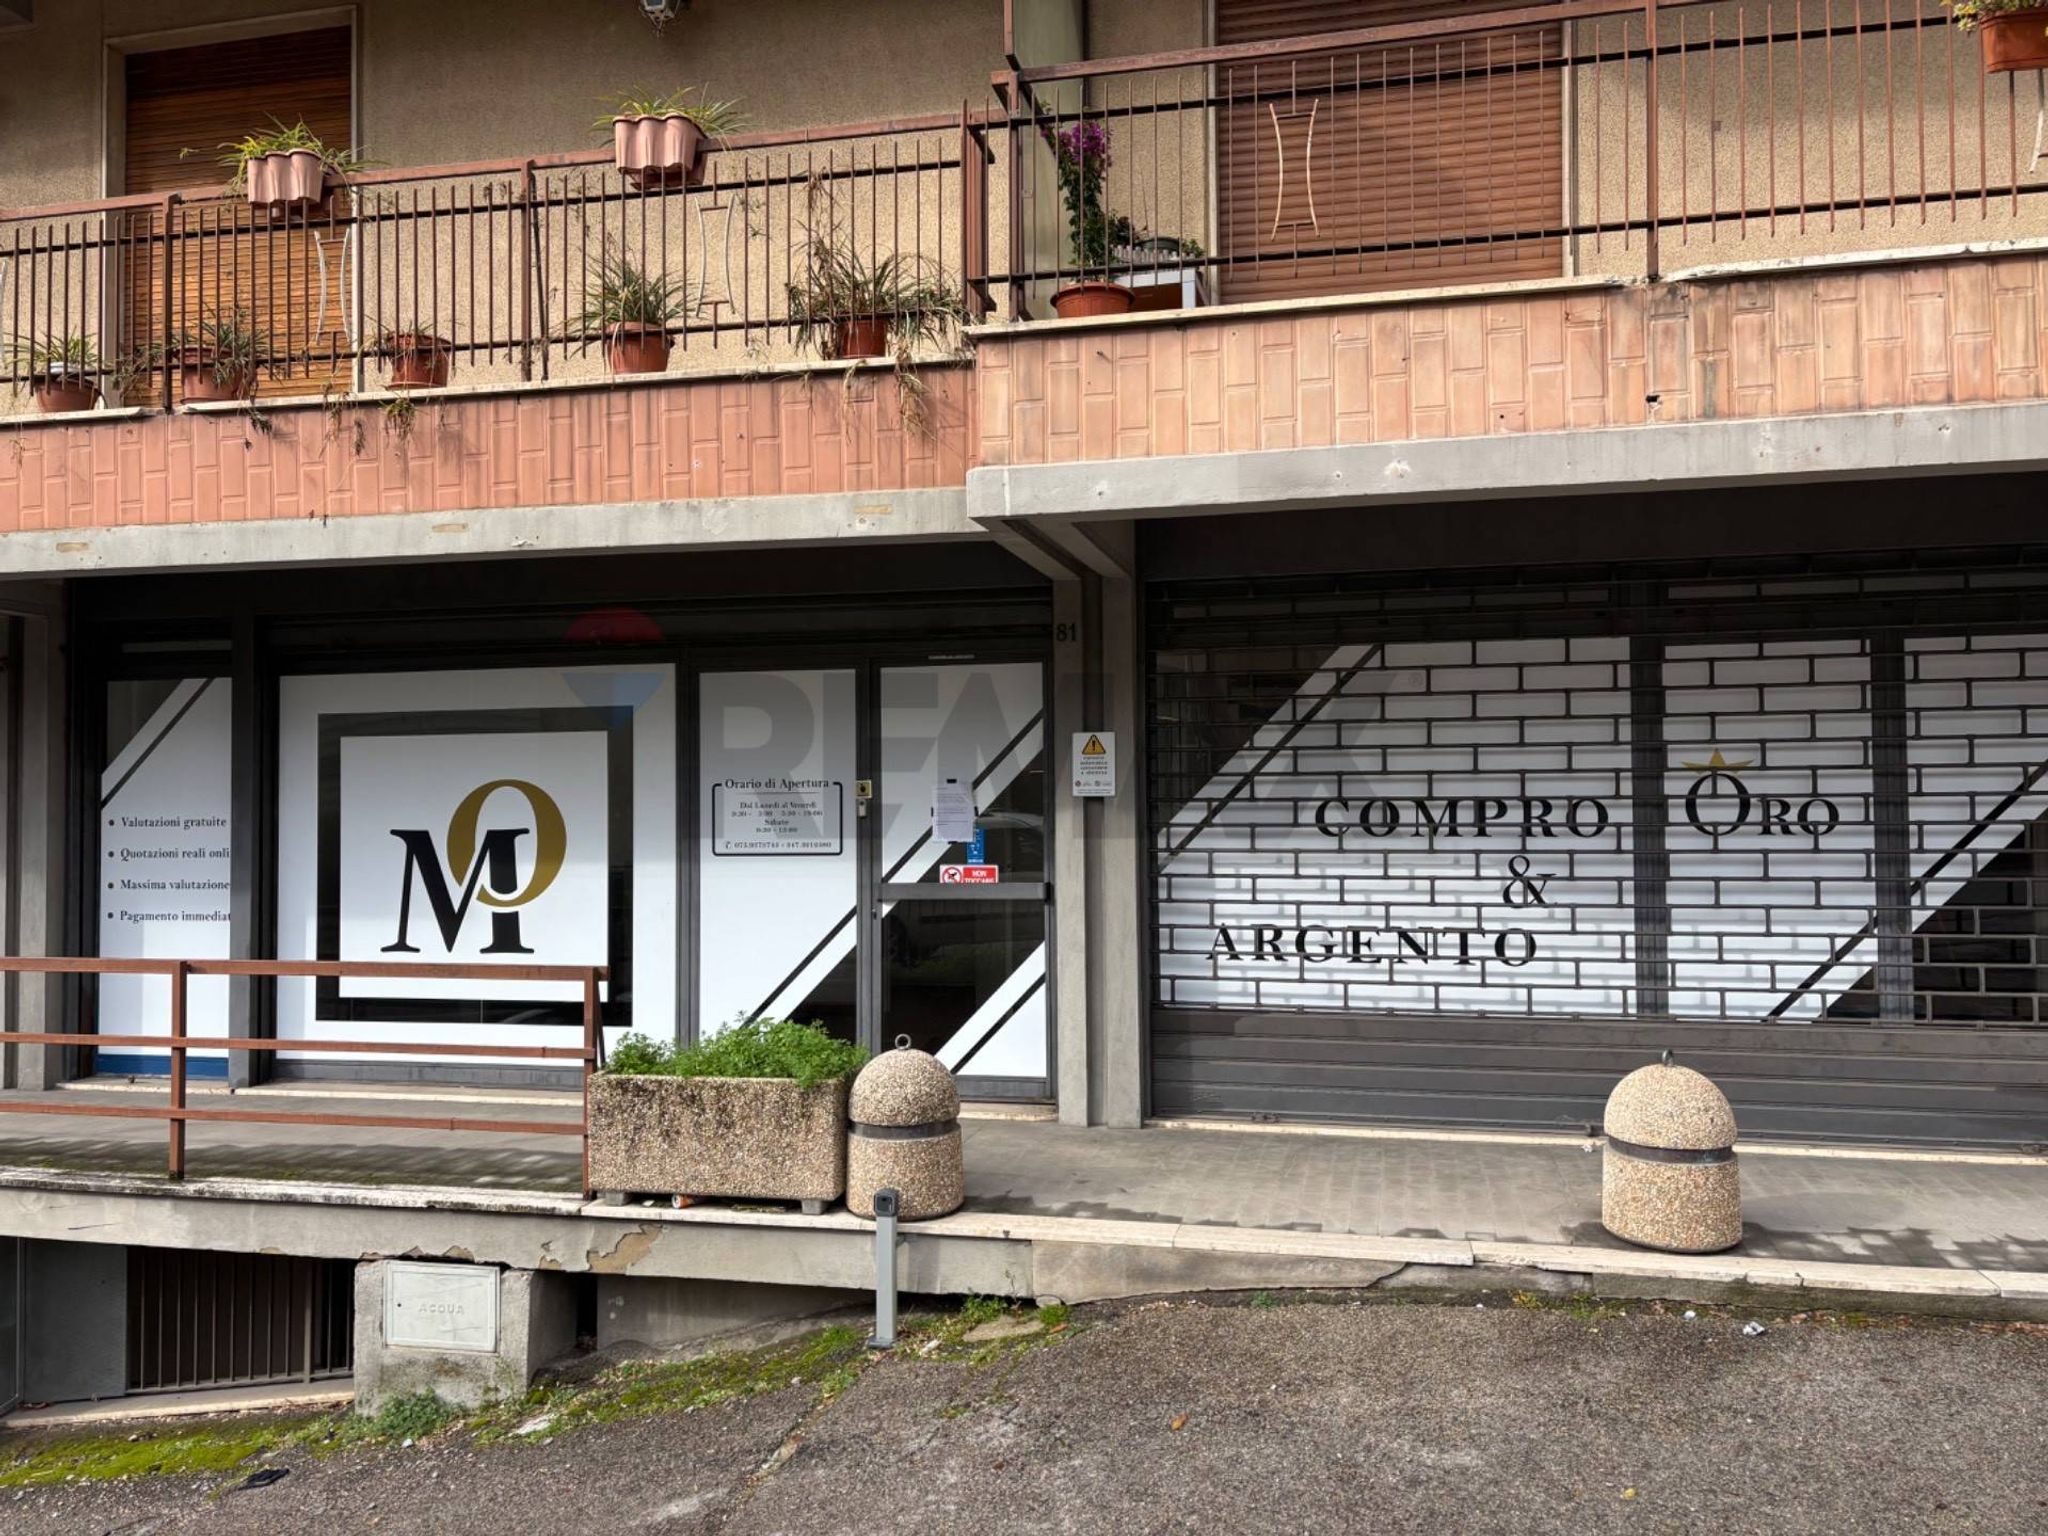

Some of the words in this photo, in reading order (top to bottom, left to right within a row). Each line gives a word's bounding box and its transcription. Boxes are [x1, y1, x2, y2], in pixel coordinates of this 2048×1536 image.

[1056, 623, 1076, 642] 81
[725, 779, 761, 789] Orario
[765, 779, 776, 789] di
[780, 778, 829, 791] Apertura
[121, 816, 181, 827] Valutazioni
[183, 816, 227, 830] gratuite
[1315, 798, 1609, 838] COMPRO
[120, 847, 180, 862] Quotazioni
[182, 847, 206, 859] reali
[208, 847, 230, 859] onli
[120, 879, 167, 890] Massima
[169, 879, 230, 890] valutazione
[1502, 855, 1557, 909] &
[120, 910, 179, 923] Pagamento
[1206, 923, 1536, 967] ARGENTO
